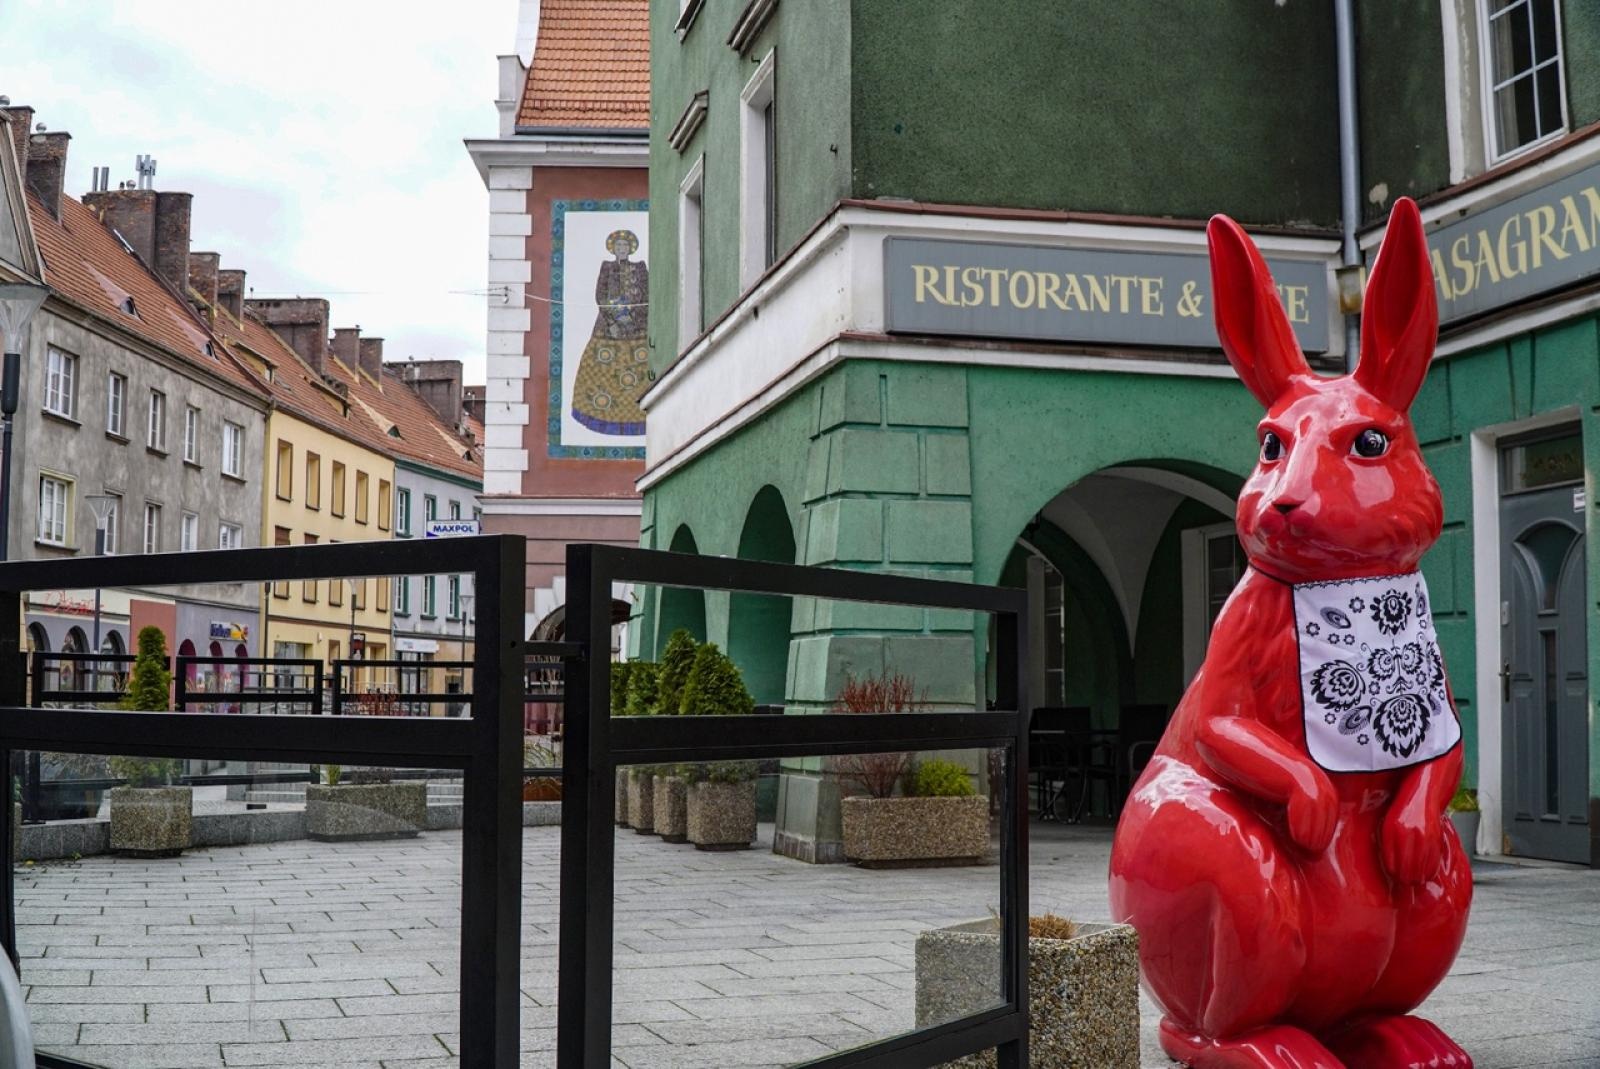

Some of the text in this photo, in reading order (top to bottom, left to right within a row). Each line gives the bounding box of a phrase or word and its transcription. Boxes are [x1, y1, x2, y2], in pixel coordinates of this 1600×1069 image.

[1360, 186, 1600, 301] ASAGRAN
[911, 264, 1204, 318] RISTORANTE &
[433, 524, 474, 533] MAXPOL
